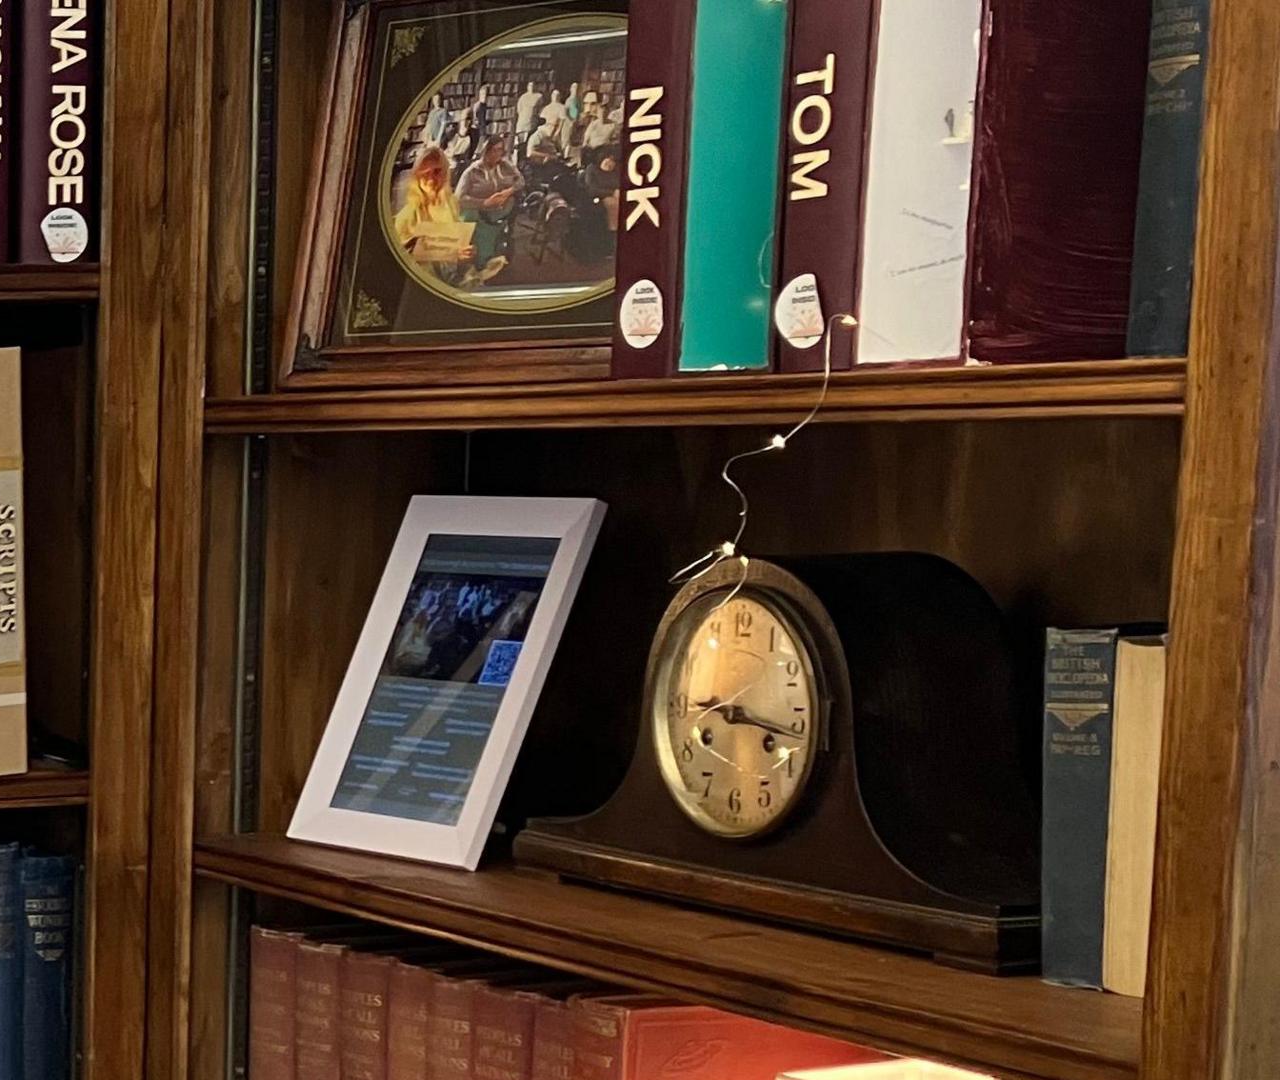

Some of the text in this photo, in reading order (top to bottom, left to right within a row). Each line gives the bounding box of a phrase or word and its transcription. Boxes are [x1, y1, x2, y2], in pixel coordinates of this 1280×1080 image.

[48, 0, 87, 206] NA ROSE
[790, 53, 835, 201] TOM
[626, 86, 664, 231] NICK
[702, 771, 715, 798] 7
[728, 788, 742, 815] 6
[757, 780, 772, 808] 5
